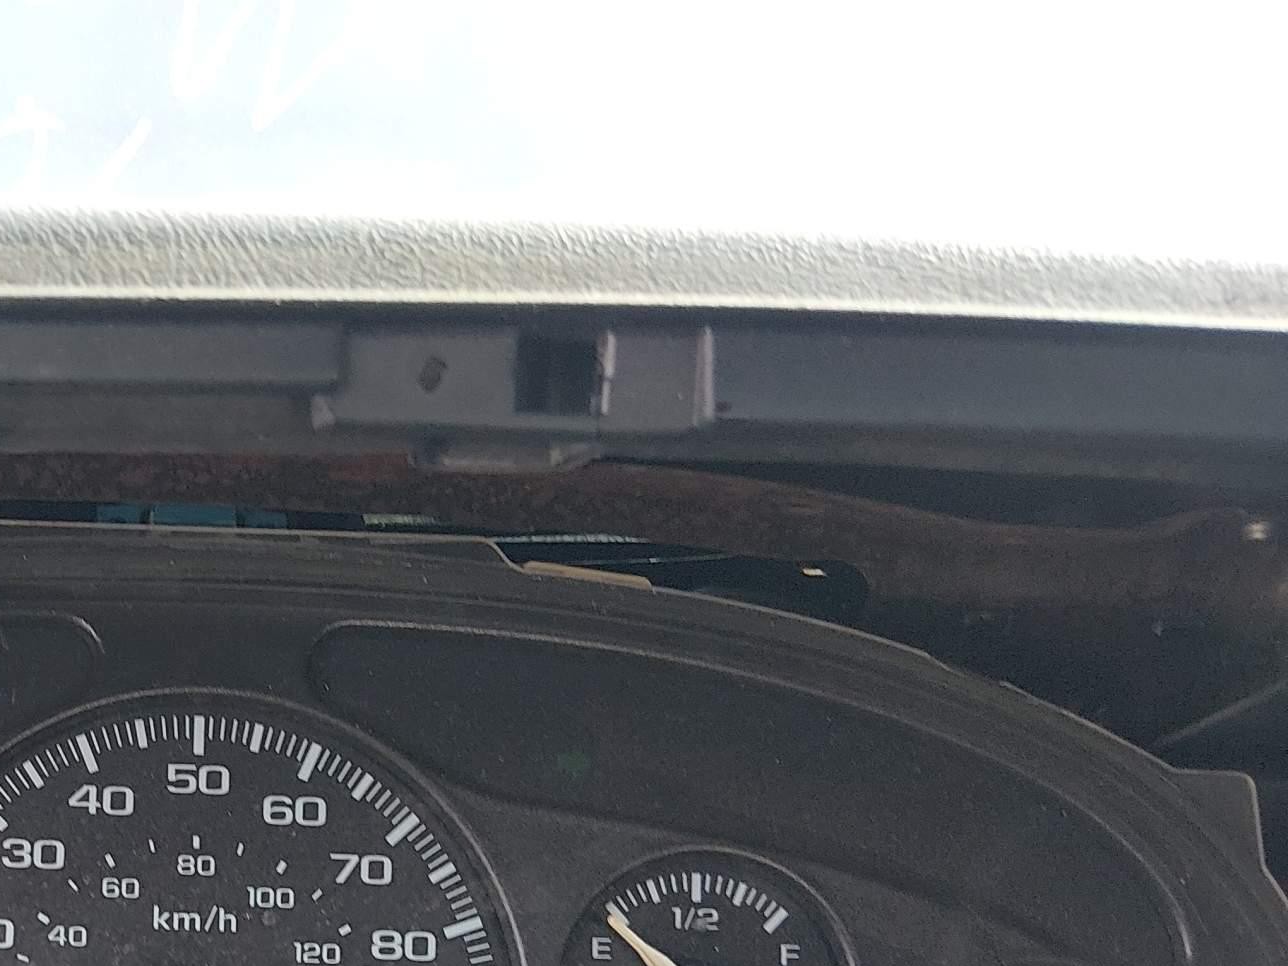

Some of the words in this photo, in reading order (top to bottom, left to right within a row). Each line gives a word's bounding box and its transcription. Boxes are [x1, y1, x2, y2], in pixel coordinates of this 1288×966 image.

[167, 764, 230, 796] 50
[67, 784, 134, 816] 40
[262, 796, 327, 827] 60
[2, 838, 65, 870] 30
[177, 853, 215, 876] 80
[330, 852, 393, 885] 70
[101, 876, 140, 899] 60
[247, 885, 295, 910] 100
[152, 904, 239, 934] km/h
[673, 907, 719, 931] 1/2
[48, 925, 88, 948] 40
[371, 929, 438, 962] 80
[592, 937, 611, 959] E
[294, 942, 342, 966] 120
[781, 945, 800, 966] F
